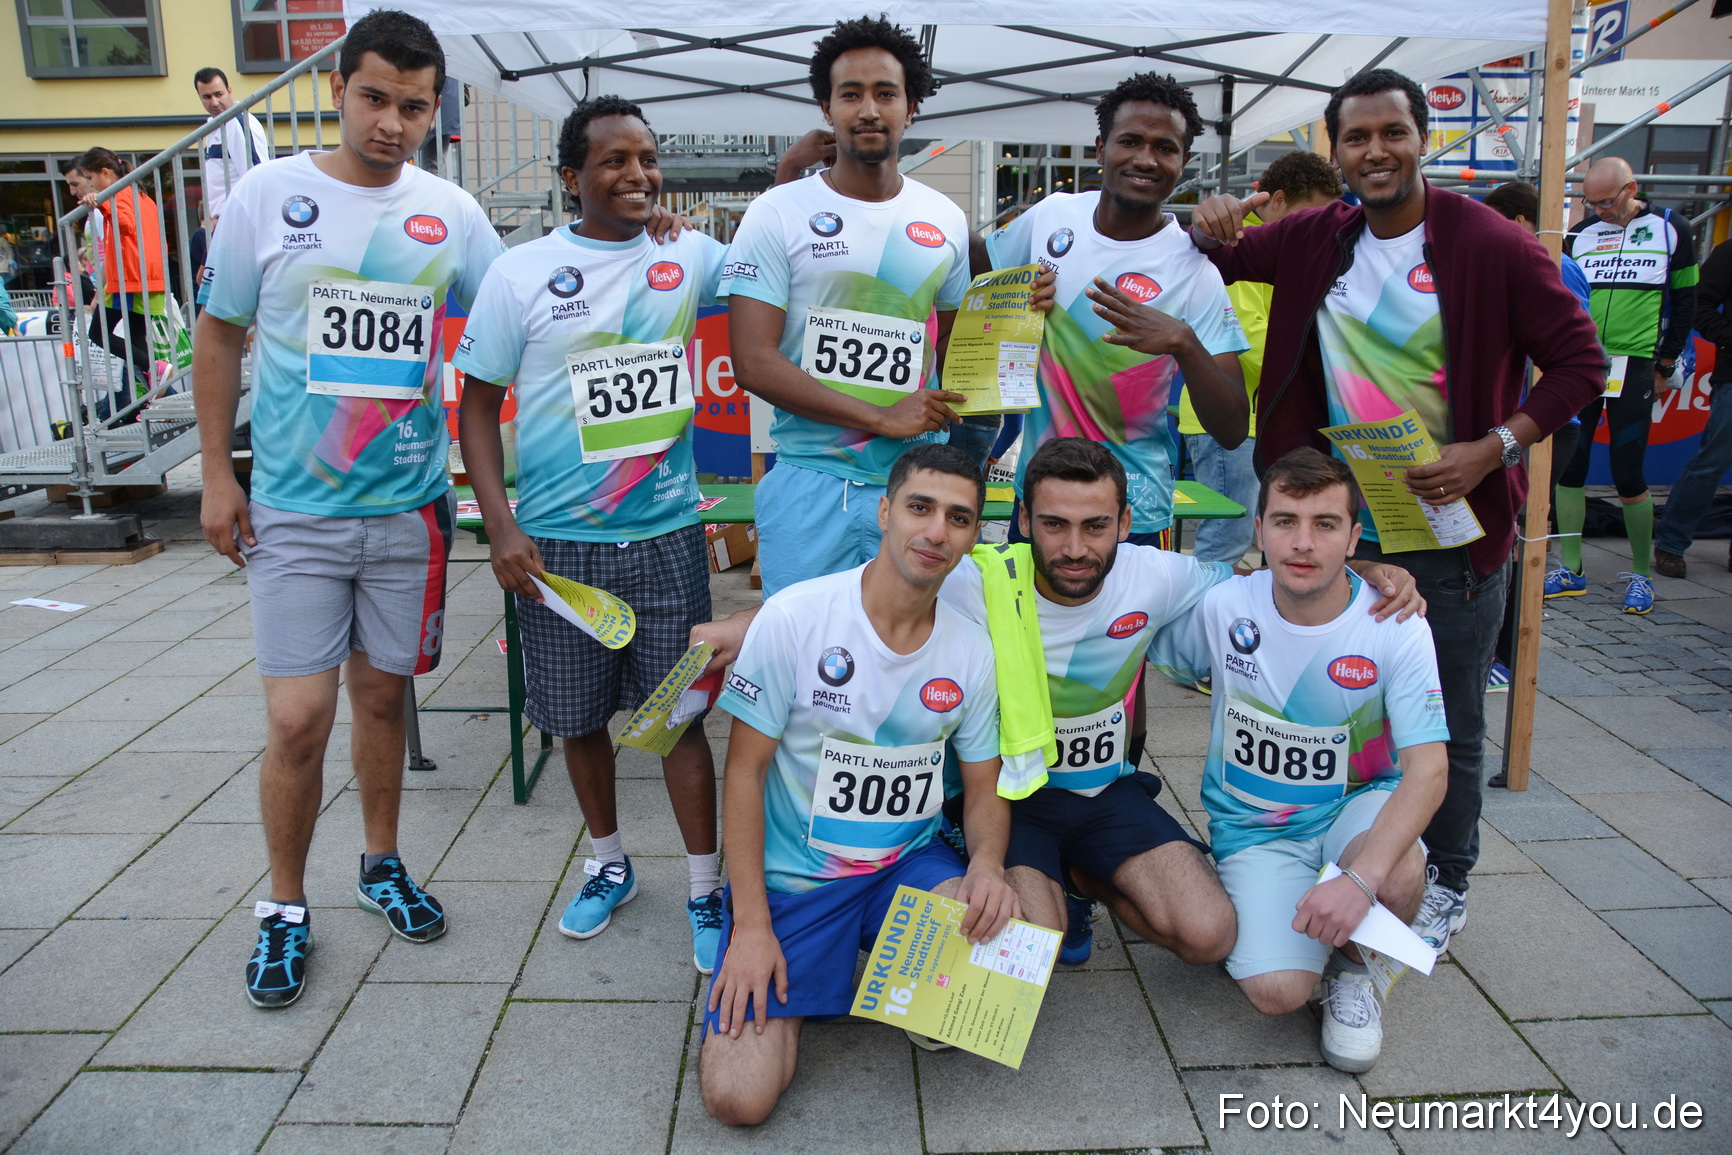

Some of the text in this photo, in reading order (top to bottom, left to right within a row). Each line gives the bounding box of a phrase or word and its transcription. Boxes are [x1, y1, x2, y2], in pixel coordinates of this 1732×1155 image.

[1429, 90, 1462, 107] Hervis
[1582, 85, 1660, 97] Unterer Markt 15
[283, 233, 321, 244] PARTL
[410, 221, 443, 237] Hervis
[911, 226, 942, 242] Hervis
[282, 242, 322, 251] Neumarkt
[811, 240, 849, 252] PARTL
[812, 249, 849, 259] Neumarkt
[1584, 257, 1656, 269] Laufteam
[651, 268, 680, 284] Hervis
[1594, 269, 1637, 280] Fürth
[991, 291, 1032, 301] Neumarkt
[1121, 276, 1157, 298] Hervis
[313, 287, 418, 307] PARTL Neumarkt
[966, 293, 987, 311] 16.
[988, 300, 1029, 311] Stadtlauf
[551, 300, 589, 315] PARTL
[552, 309, 591, 322] Neumarkt
[322, 306, 424, 355] 3084
[809, 316, 906, 341] PARTL Neumarkt
[571, 350, 668, 375] PARTL Neumarkt
[815, 333, 912, 386] 5328
[587, 364, 679, 418] 5327
[397, 420, 418, 439] 16.
[582, 417, 588, 425] S
[1329, 418, 1419, 441] URKUNDE
[1342, 444, 1374, 460] 16.
[1368, 437, 1425, 452] Neumarkter
[1373, 451, 1416, 462] Stadtlauf
[657, 460, 672, 479] 16.
[1225, 654, 1258, 674] PARTL
[1225, 663, 1258, 681] Neumarkt
[1335, 662, 1374, 681] Hervis
[813, 689, 851, 706] PARTL
[926, 685, 957, 704] Hervis
[812, 700, 851, 714] Neumarkt
[628, 715, 661, 739] 16.
[1227, 707, 1326, 745] PARTL Neumarkt
[824, 749, 928, 769] PARTL Neumarkt
[1234, 728, 1336, 781] 3089
[828, 770, 934, 817] 3087
[898, 900, 934, 976] Neumarkter
[860, 893, 918, 1011] URKUNDE
[910, 918, 942, 979] Stadtlauf
[930, 942, 945, 973] September
[943, 924, 952, 941] 2015
[885, 982, 917, 1016] 16.
[971, 997, 983, 1026] Gesamtplatz
[983, 971, 991, 988] Männer
[946, 983, 967, 1038] Achmed Gangi Zade
